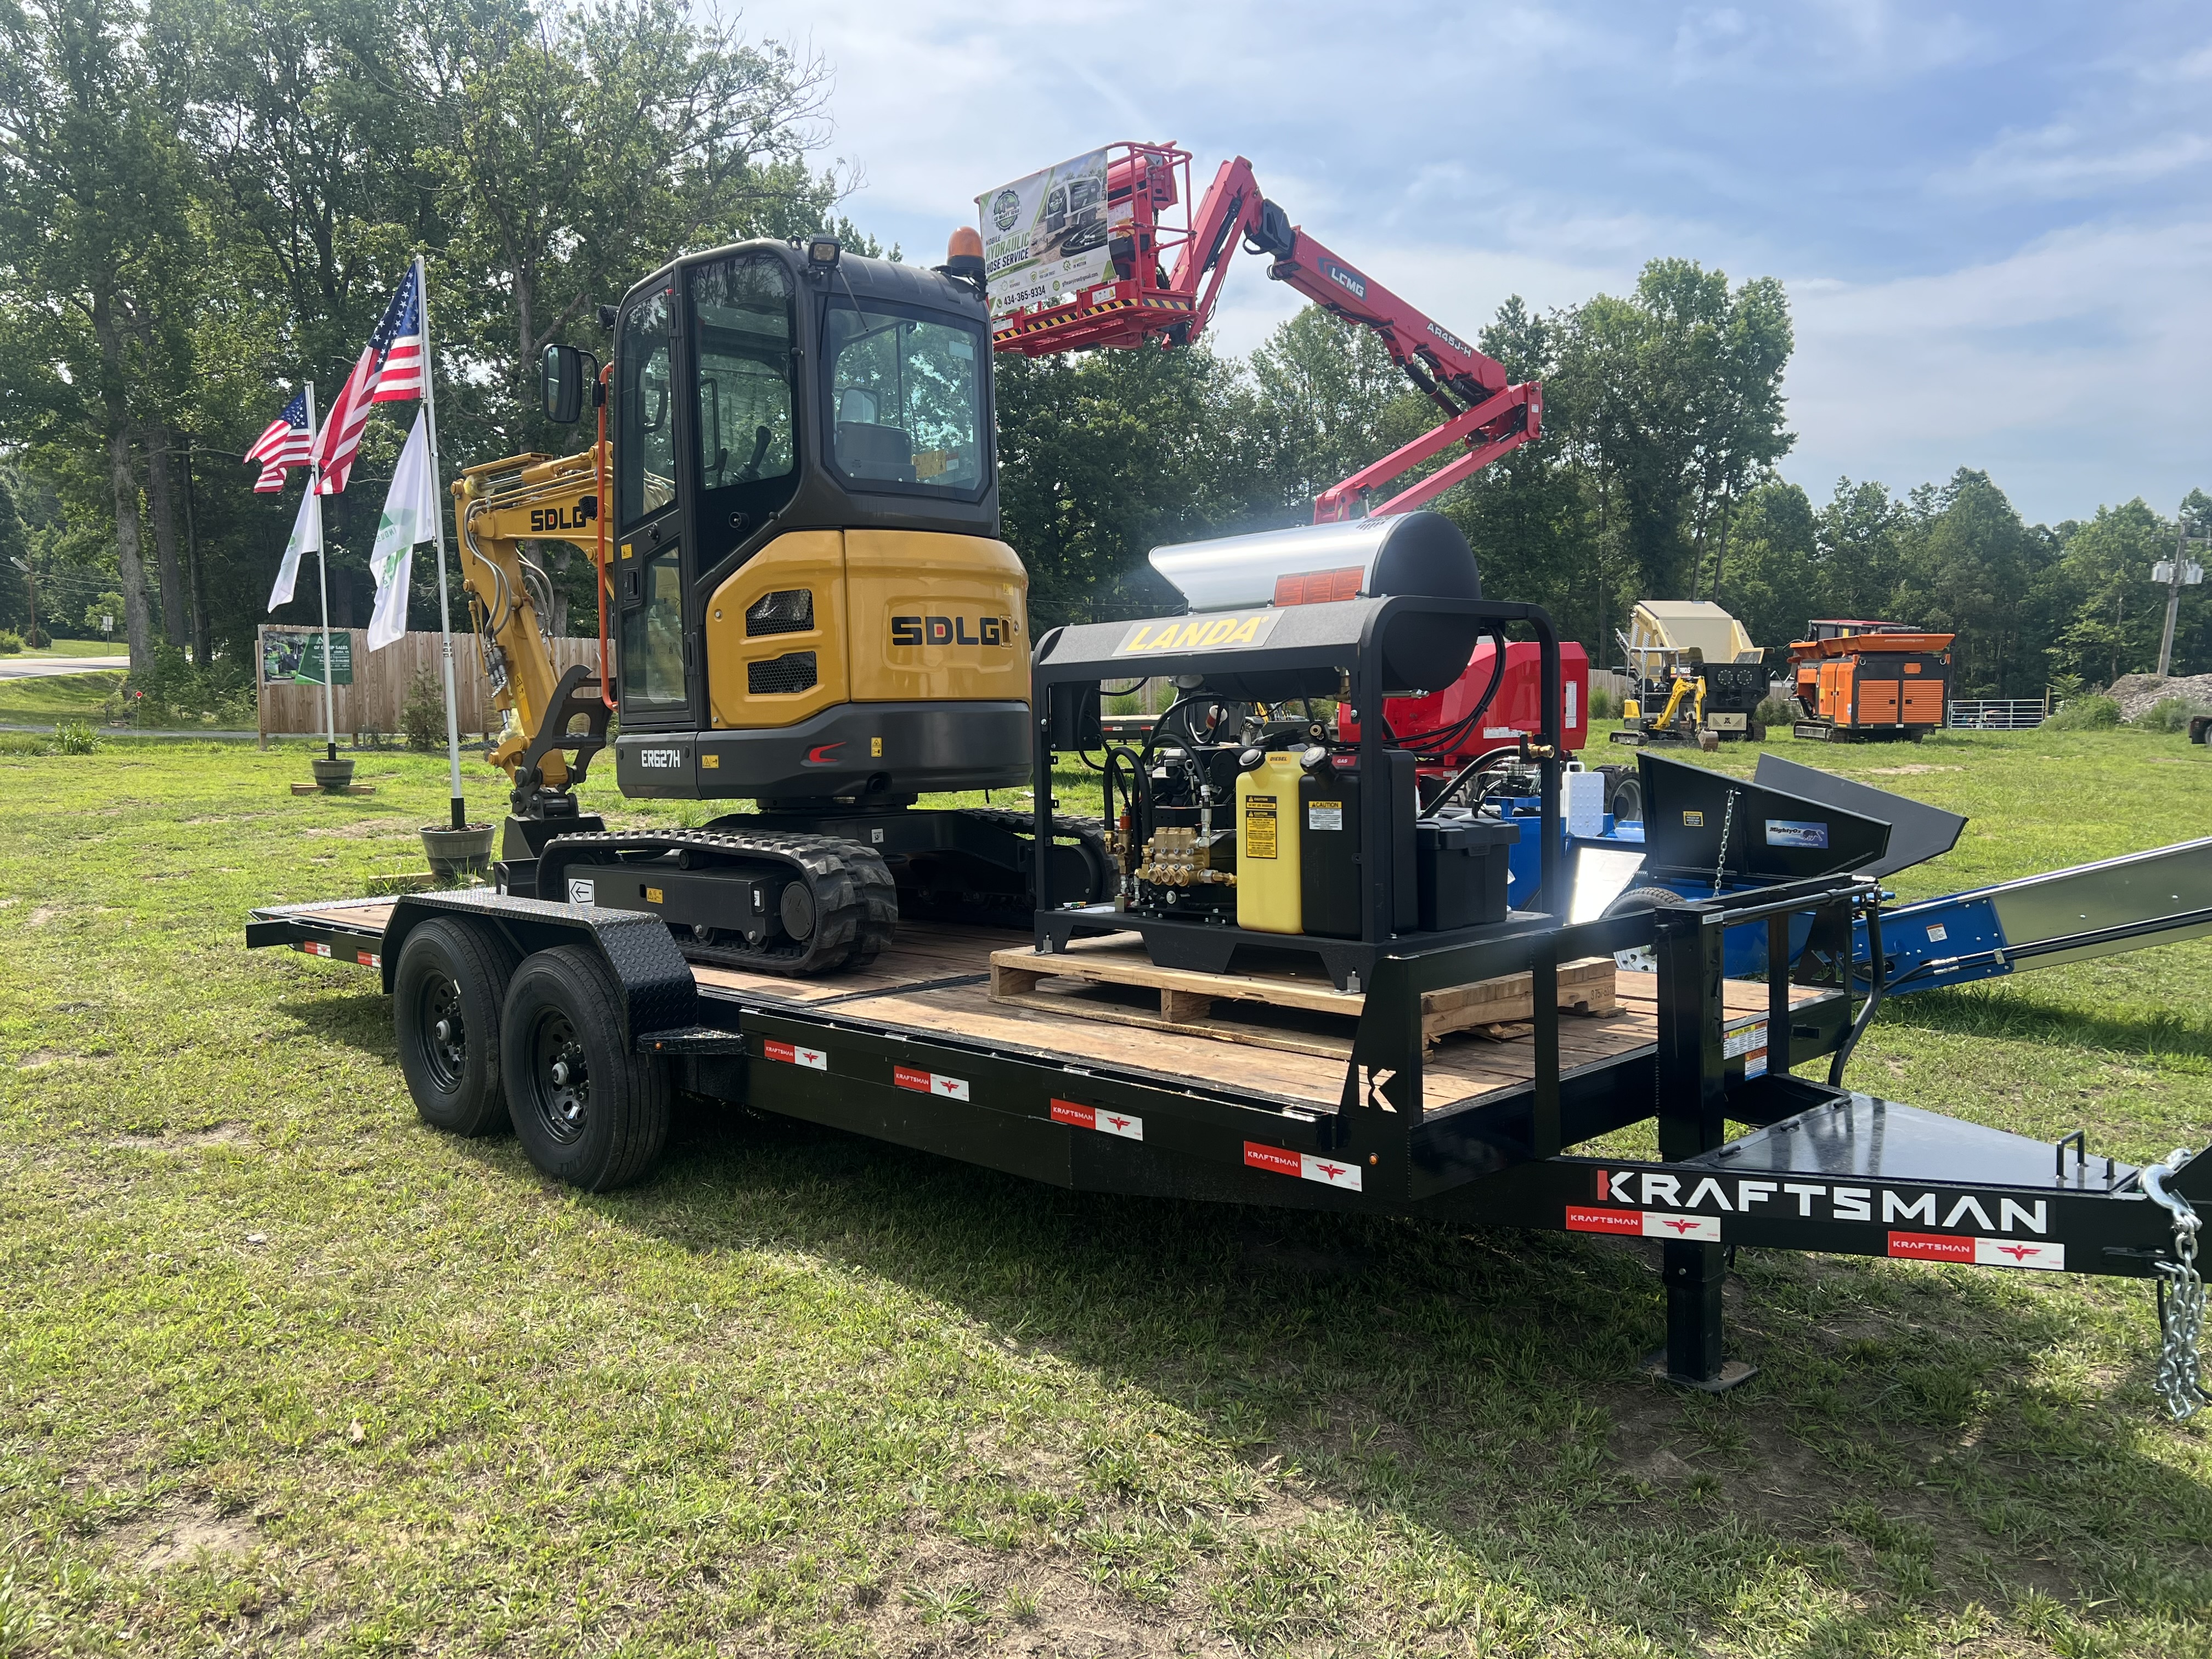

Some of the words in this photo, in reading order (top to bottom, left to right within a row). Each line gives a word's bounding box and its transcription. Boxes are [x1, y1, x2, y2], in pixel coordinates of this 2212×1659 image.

[986, 234, 1001, 246] MOBILE
[986, 232, 1030, 262] HYDRAULIC
[986, 258, 1001, 274] HOSE
[1002, 247, 1029, 267] SERVICE
[1331, 267, 1364, 297] LCMG
[1004, 285, 1046, 306] 434-365-9334
[531, 506, 586, 532] SDLG
[891, 616, 1000, 646] SDLG
[641, 749, 680, 768] ER627H
[765, 1046, 794, 1057] KRAFTSMAN
[895, 1073, 929, 1085] KRAFTSMAN
[1053, 1106, 1093, 1121] KRAFTSMAN
[1248, 1150, 1299, 1168] KRAFTSMAN
[1597, 1170, 2047, 1234] KRAFTSMAN
[1570, 1214, 1639, 1226] KRAFTSMAN
[1893, 1240, 1970, 1253] KRAFTSMAN
